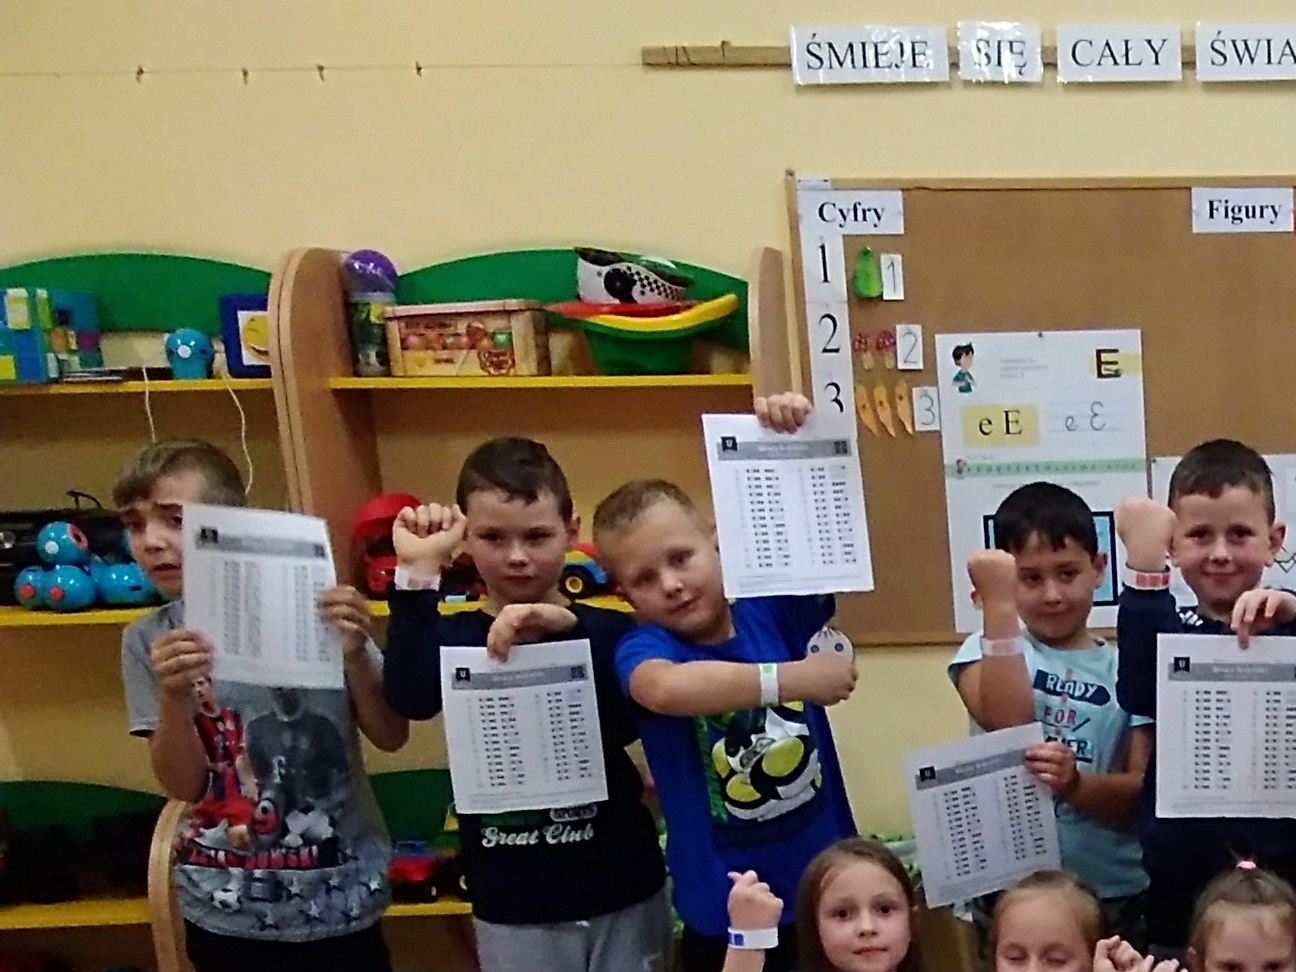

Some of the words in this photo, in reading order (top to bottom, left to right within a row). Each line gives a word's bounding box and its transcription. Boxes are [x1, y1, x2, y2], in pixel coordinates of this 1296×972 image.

[805, 33, 930, 70] ŚMIEJE
[974, 37, 1028, 76] SIĘ
[1070, 38, 1168, 68] CAŁY
[817, 200, 886, 225] Cyfry
[1208, 198, 1282, 224] Figury
[819, 243, 830, 283] 1
[887, 260, 897, 294] 1
[818, 313, 840, 354] 2
[901, 332, 918, 365] 2
[1095, 348, 1122, 380] E
[919, 393, 936, 426] 3
[978, 416, 993, 436] e
[1003, 409, 1023, 435] E
[1044, 706, 1077, 725] FOR
[481, 826, 539, 848] Great
[543, 823, 595, 844] Club
